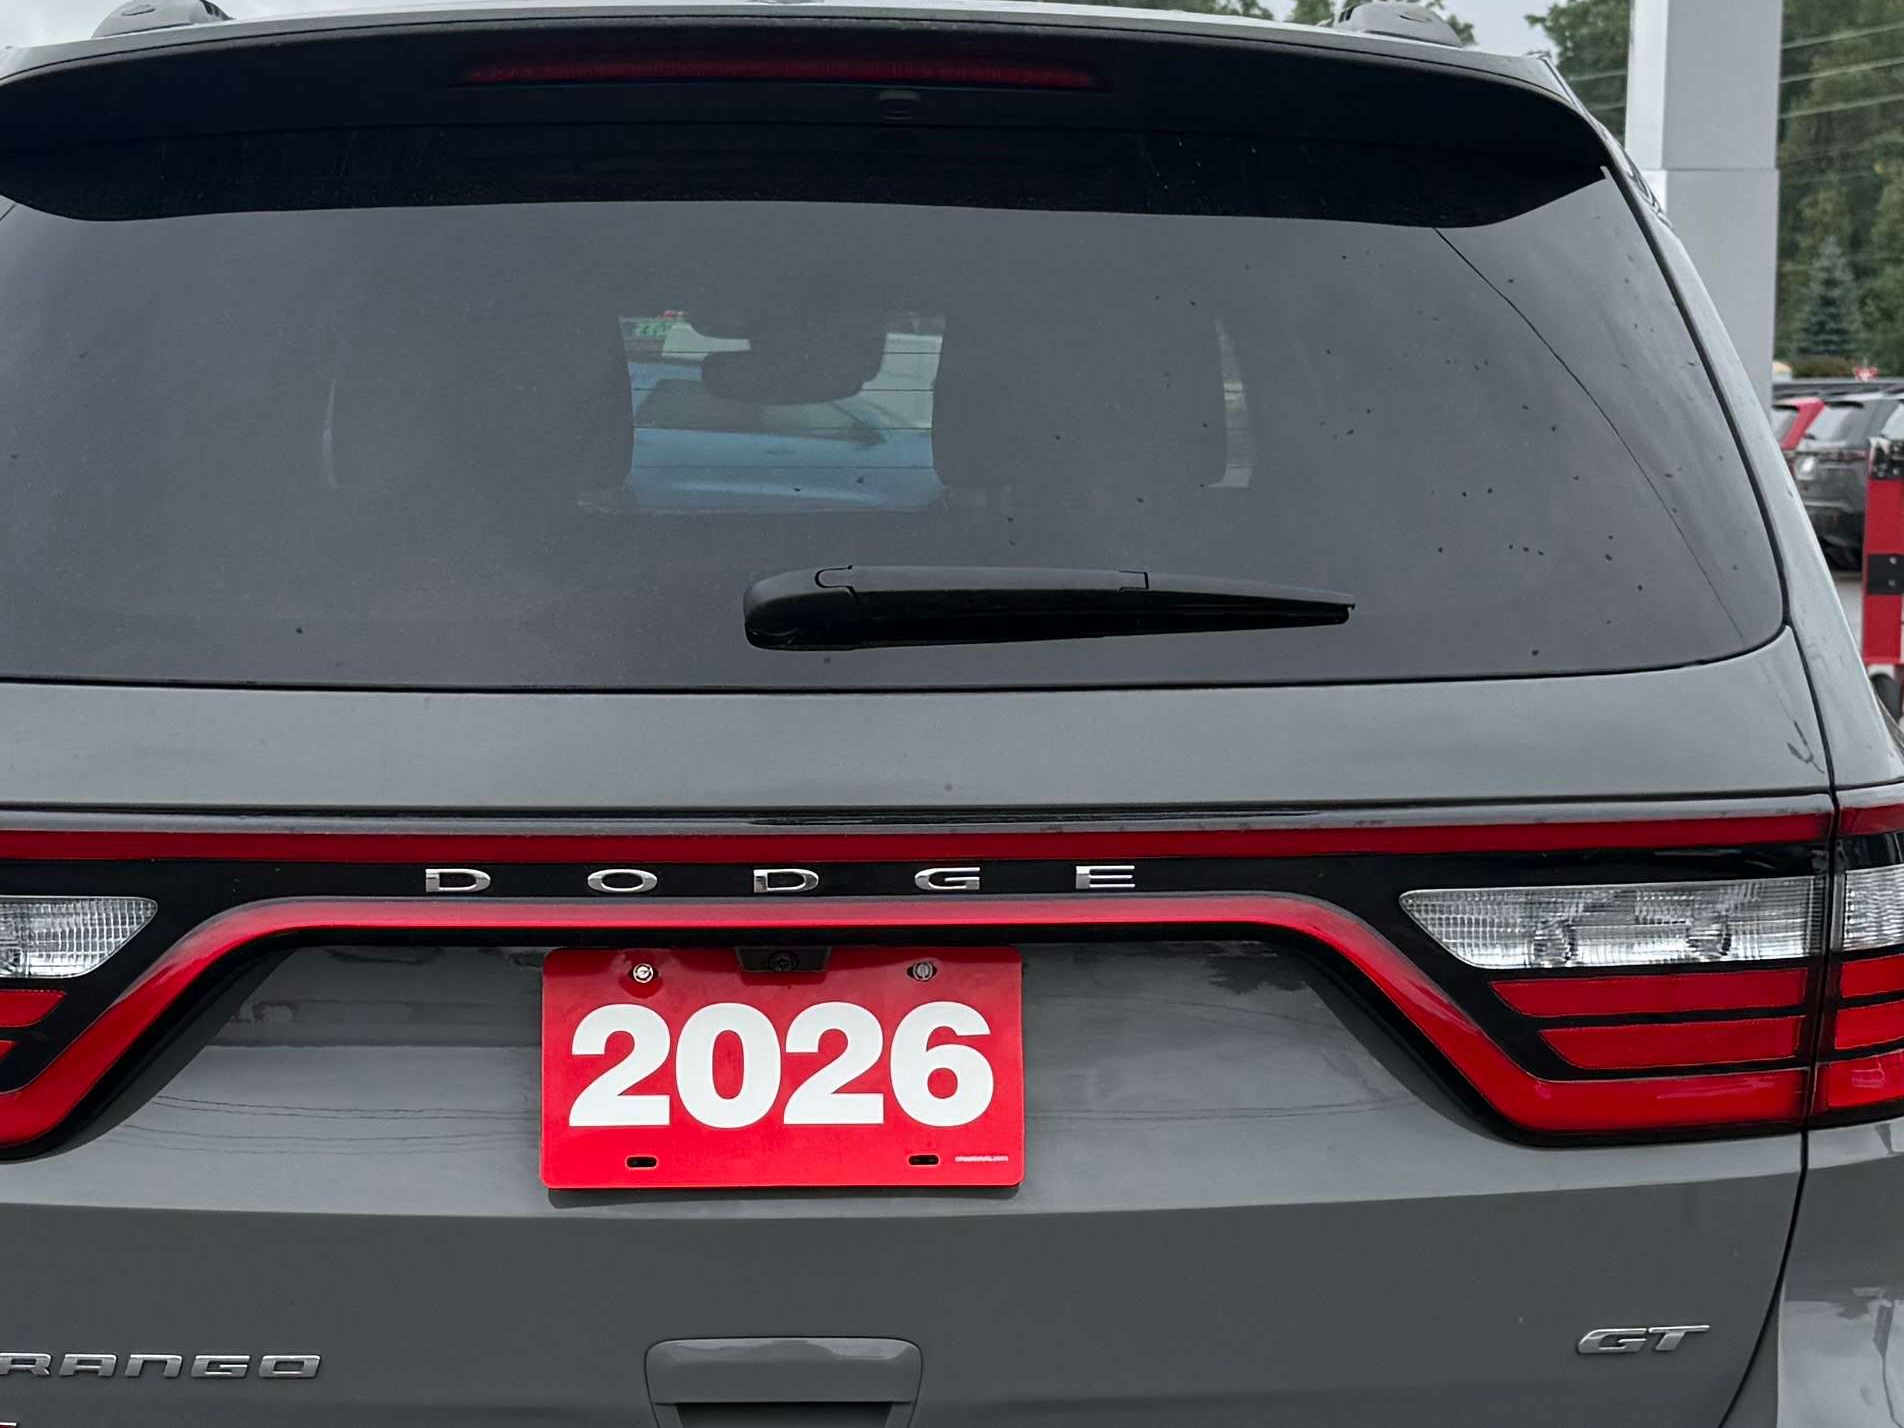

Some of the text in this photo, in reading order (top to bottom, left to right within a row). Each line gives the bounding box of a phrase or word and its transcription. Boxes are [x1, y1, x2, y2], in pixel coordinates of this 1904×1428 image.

[424, 865, 1137, 894] DODGE
[568, 1002, 995, 1128] 2026
[1577, 1324, 1711, 1355] GT
